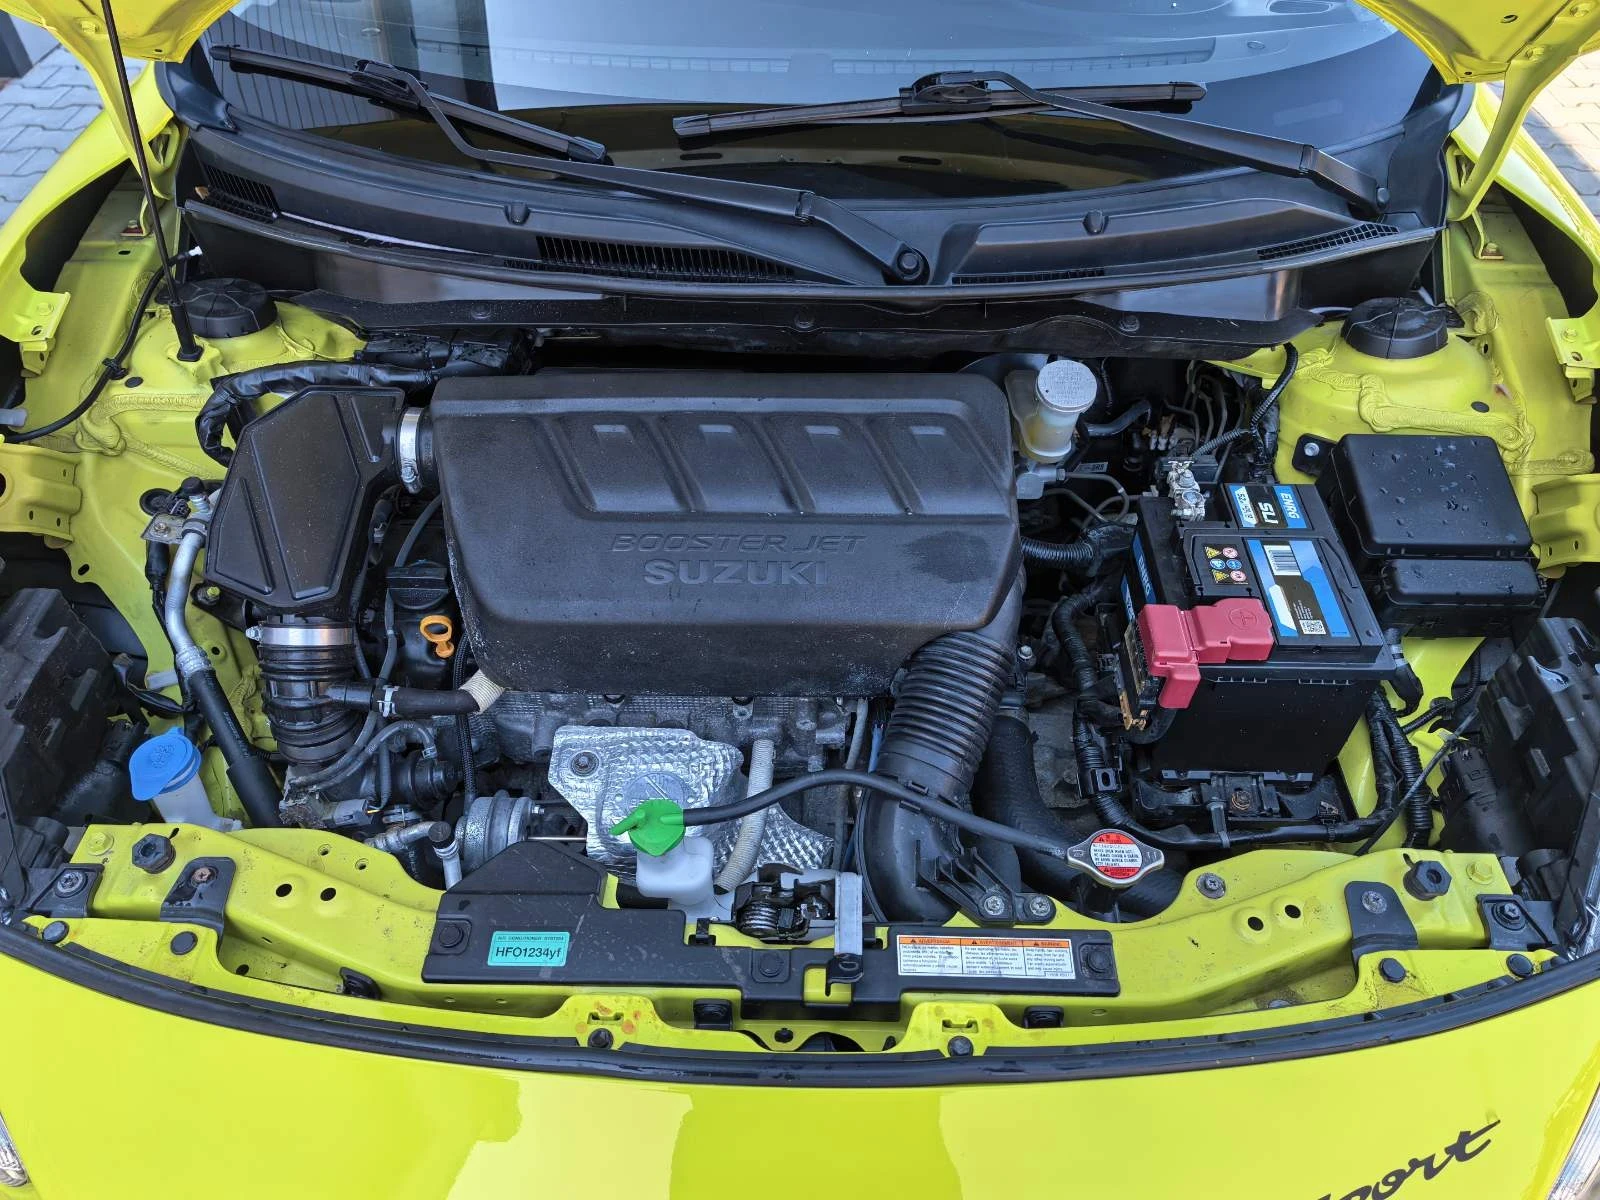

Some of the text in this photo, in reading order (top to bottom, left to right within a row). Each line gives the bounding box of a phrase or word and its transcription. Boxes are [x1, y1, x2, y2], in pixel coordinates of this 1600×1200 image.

[1258, 502, 1278, 524] SLI
[1280, 493, 1299, 519] ENRG
[611, 533, 866, 552] BOOSTER JET
[644, 558, 828, 585] SUZUKI
[495, 947, 561, 960] HFO1234yf
